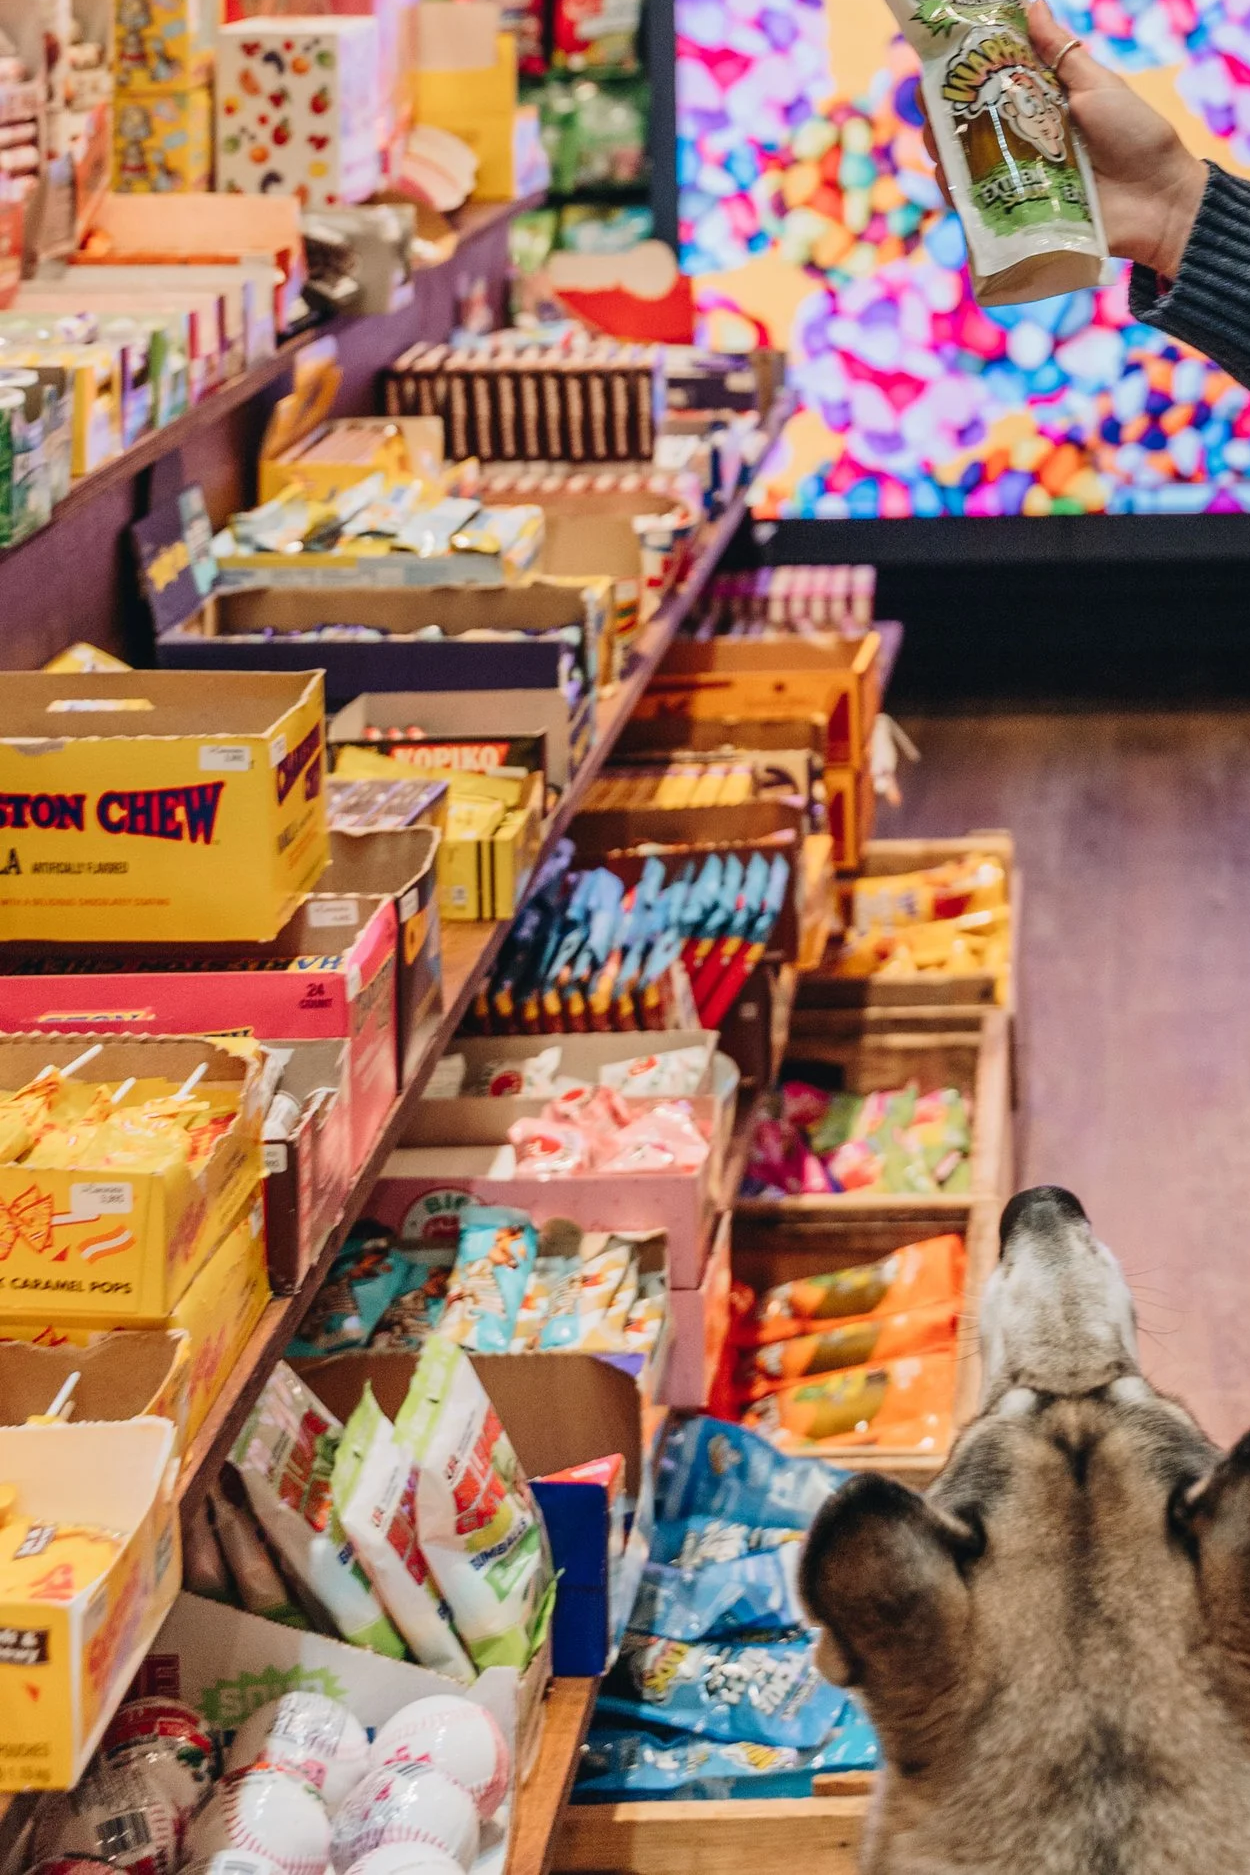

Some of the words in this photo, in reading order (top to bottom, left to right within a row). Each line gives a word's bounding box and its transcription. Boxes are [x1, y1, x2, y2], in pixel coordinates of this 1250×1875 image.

[96, 780, 225, 845] CHEW
[0, 848, 22, 875] A
[10, 1278, 86, 1293] CARAMEL
[88, 1281, 133, 1295] POPS
